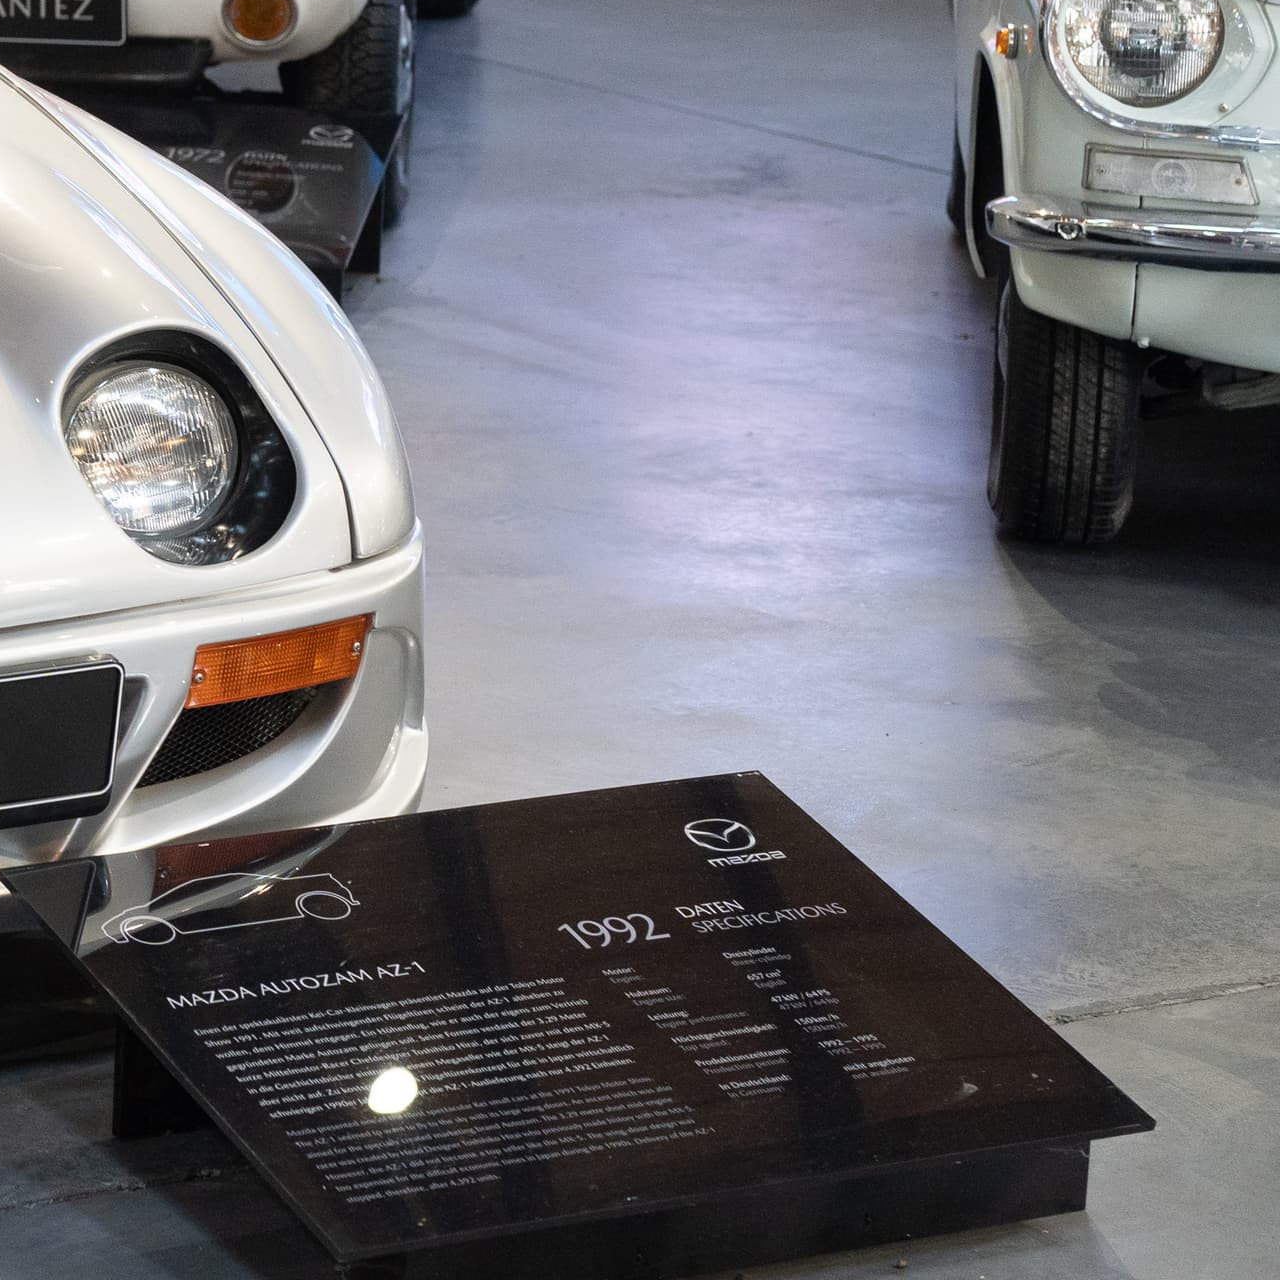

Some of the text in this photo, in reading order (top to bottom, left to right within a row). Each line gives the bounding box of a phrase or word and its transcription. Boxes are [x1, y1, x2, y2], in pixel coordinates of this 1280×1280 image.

[166, 146, 226, 164] 1972
[707, 850, 787, 868] mazda
[675, 899, 745, 919] DATEN
[691, 902, 847, 934] SPECIFICATIONS
[557, 913, 671, 950] 1992
[166, 961, 427, 1010] MAZDA AUTOZAM AZ-1
